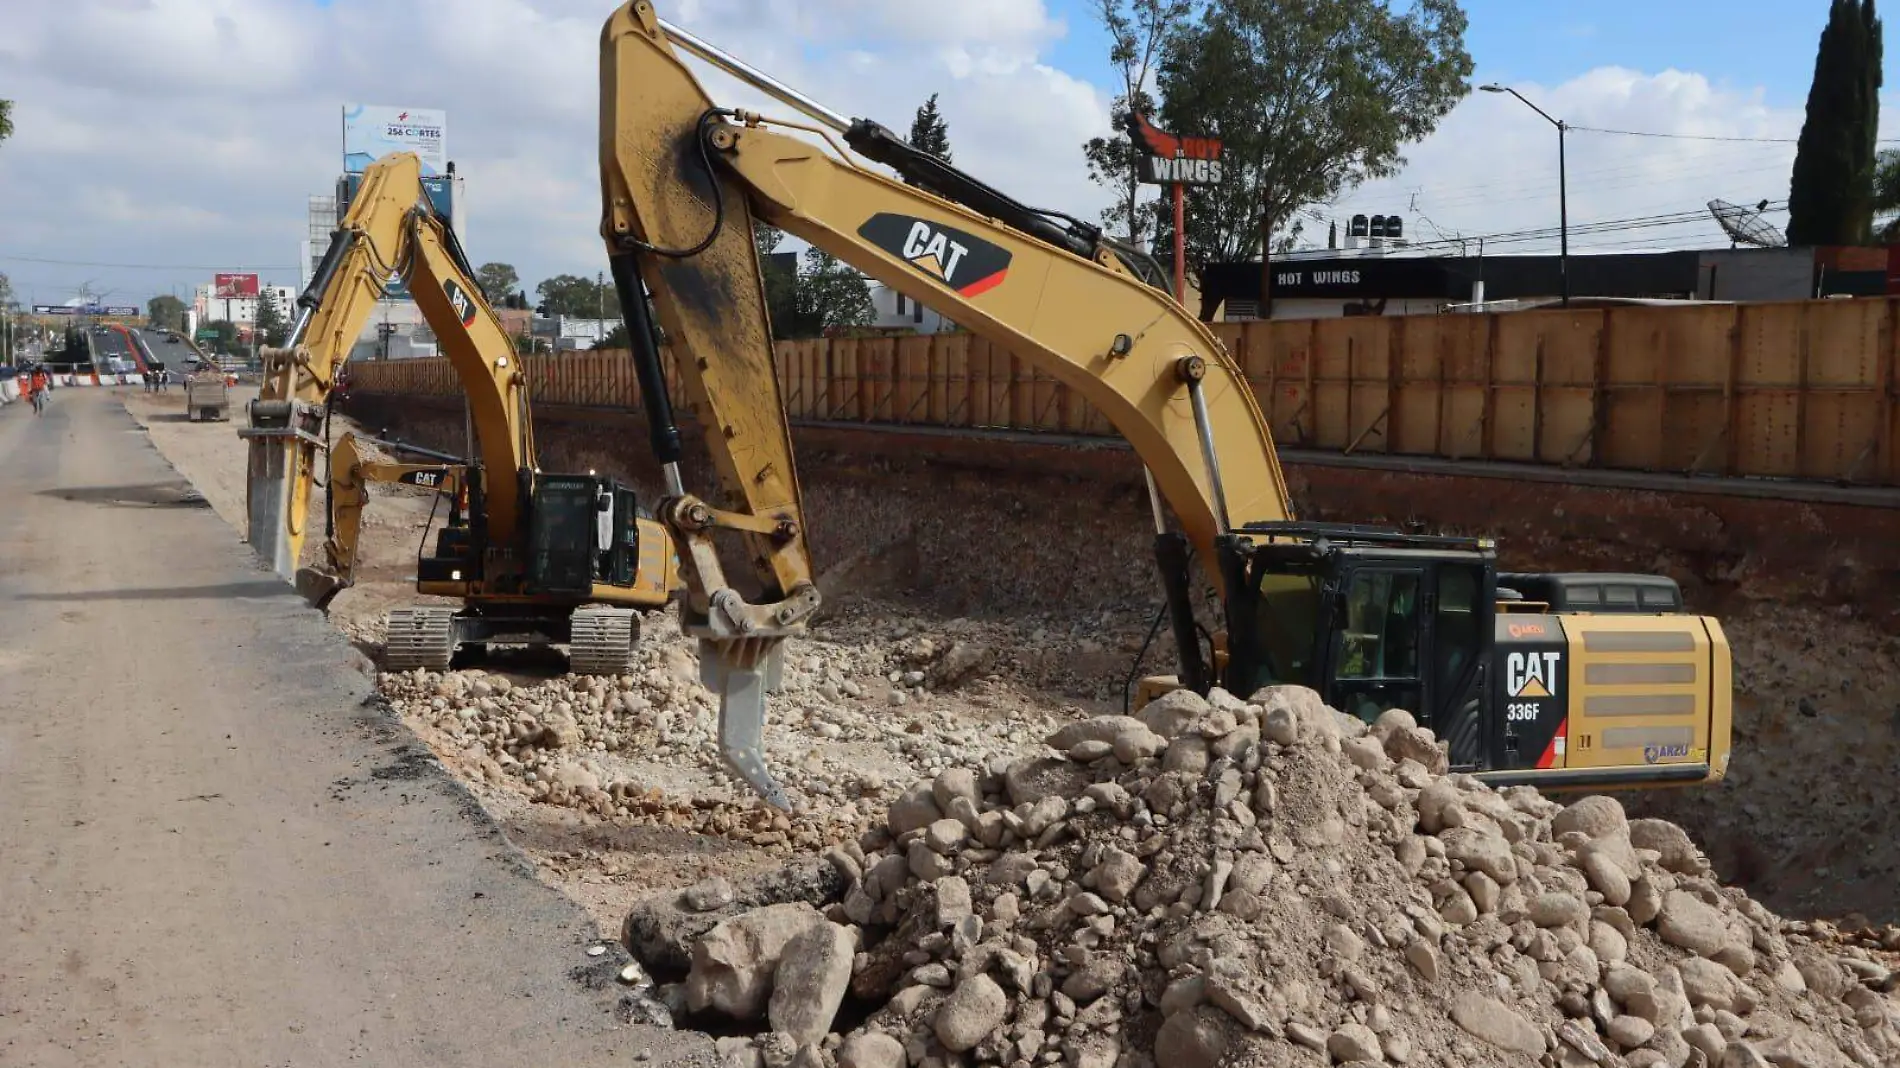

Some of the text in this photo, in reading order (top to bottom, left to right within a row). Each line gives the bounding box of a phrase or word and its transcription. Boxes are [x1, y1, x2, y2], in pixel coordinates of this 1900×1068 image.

[387, 127, 404, 136] 256
[1181, 137, 1222, 160] HOT
[1151, 157, 1222, 183] WINGS
[903, 221, 969, 282] CAT
[1278, 270, 1361, 285] HOT WINGS
[416, 471, 437, 486] CAT
[1507, 652, 1560, 697] CAT
[1506, 703, 1540, 721] 336F
